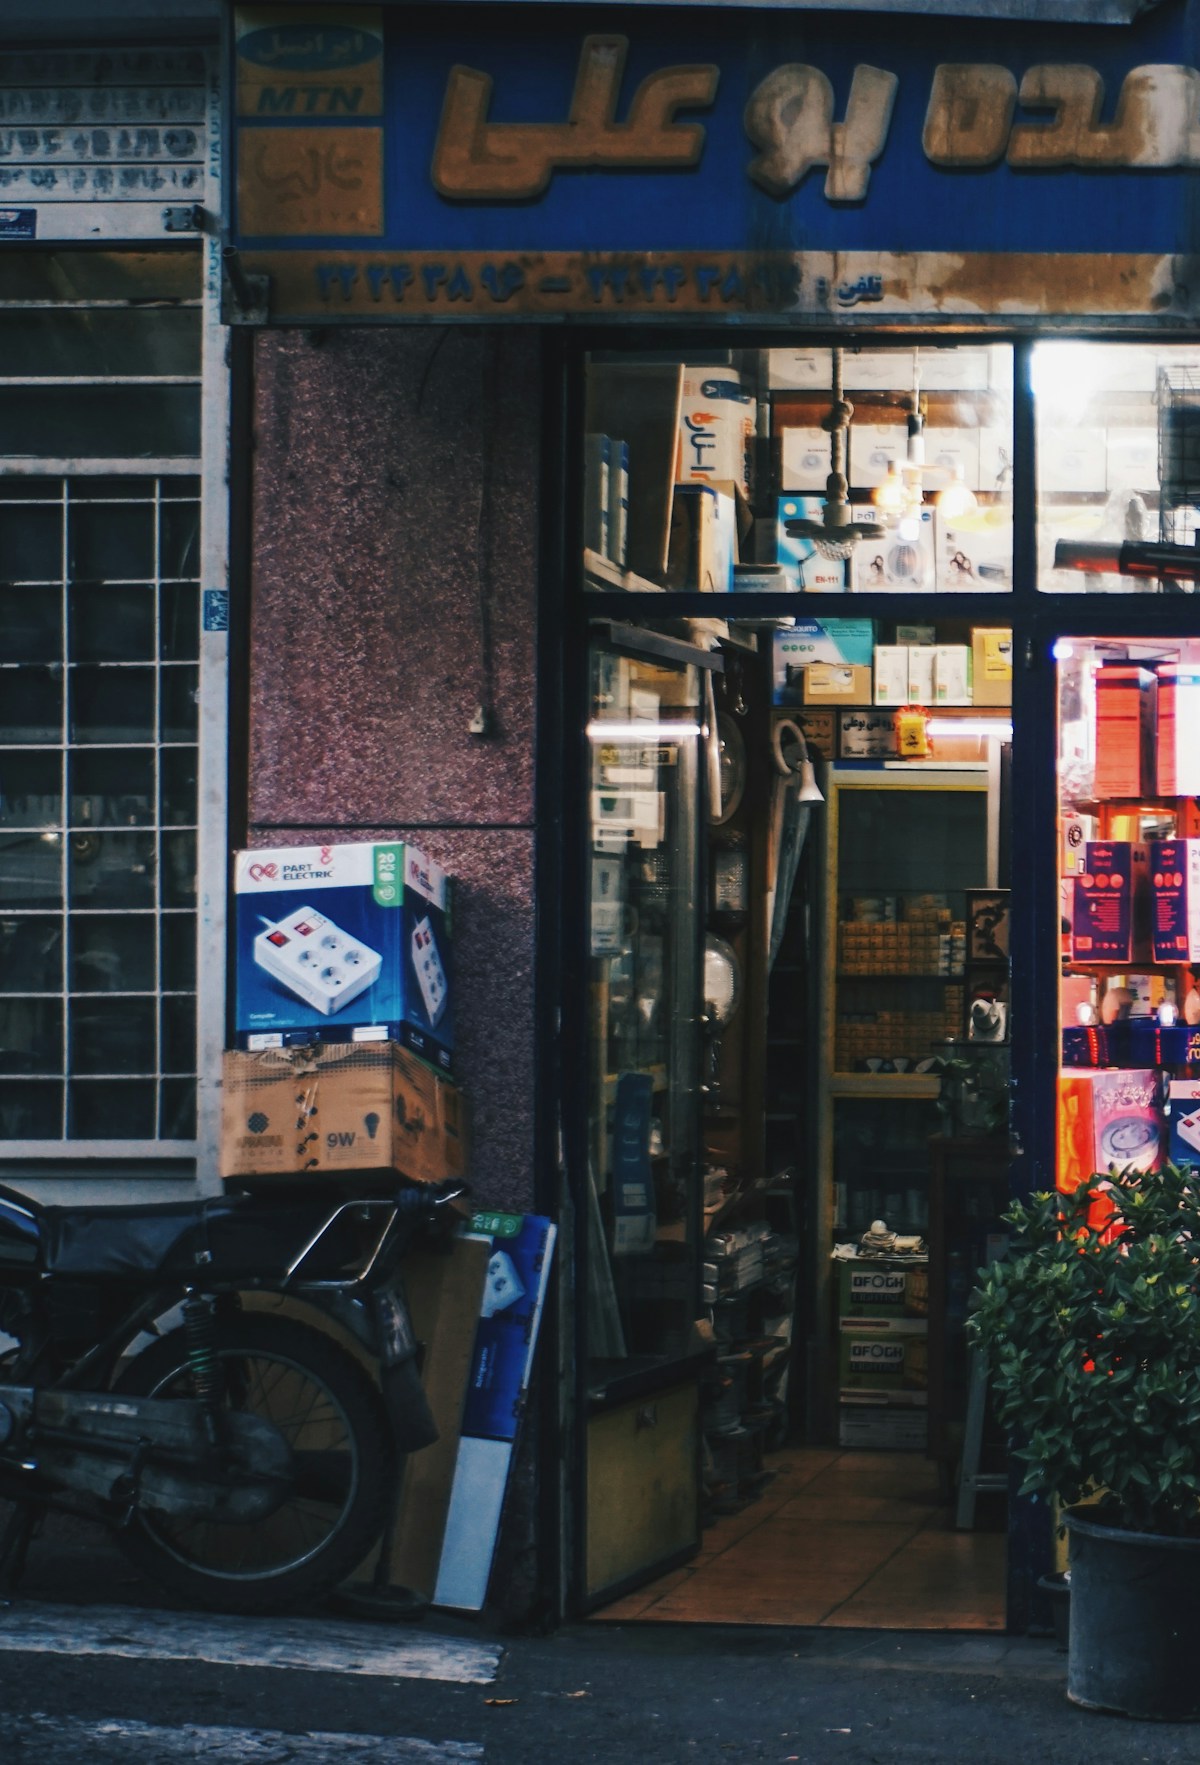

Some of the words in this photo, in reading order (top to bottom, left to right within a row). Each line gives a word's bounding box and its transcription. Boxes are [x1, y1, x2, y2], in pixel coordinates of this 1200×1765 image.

[257, 87, 363, 112] MTN
[432, 34, 720, 201] علی
[838, 274, 884, 306] تلفن
[283, 864, 315, 874] PART
[283, 870, 334, 881] ELECTRIC
[327, 1132, 355, 1147] 9W
